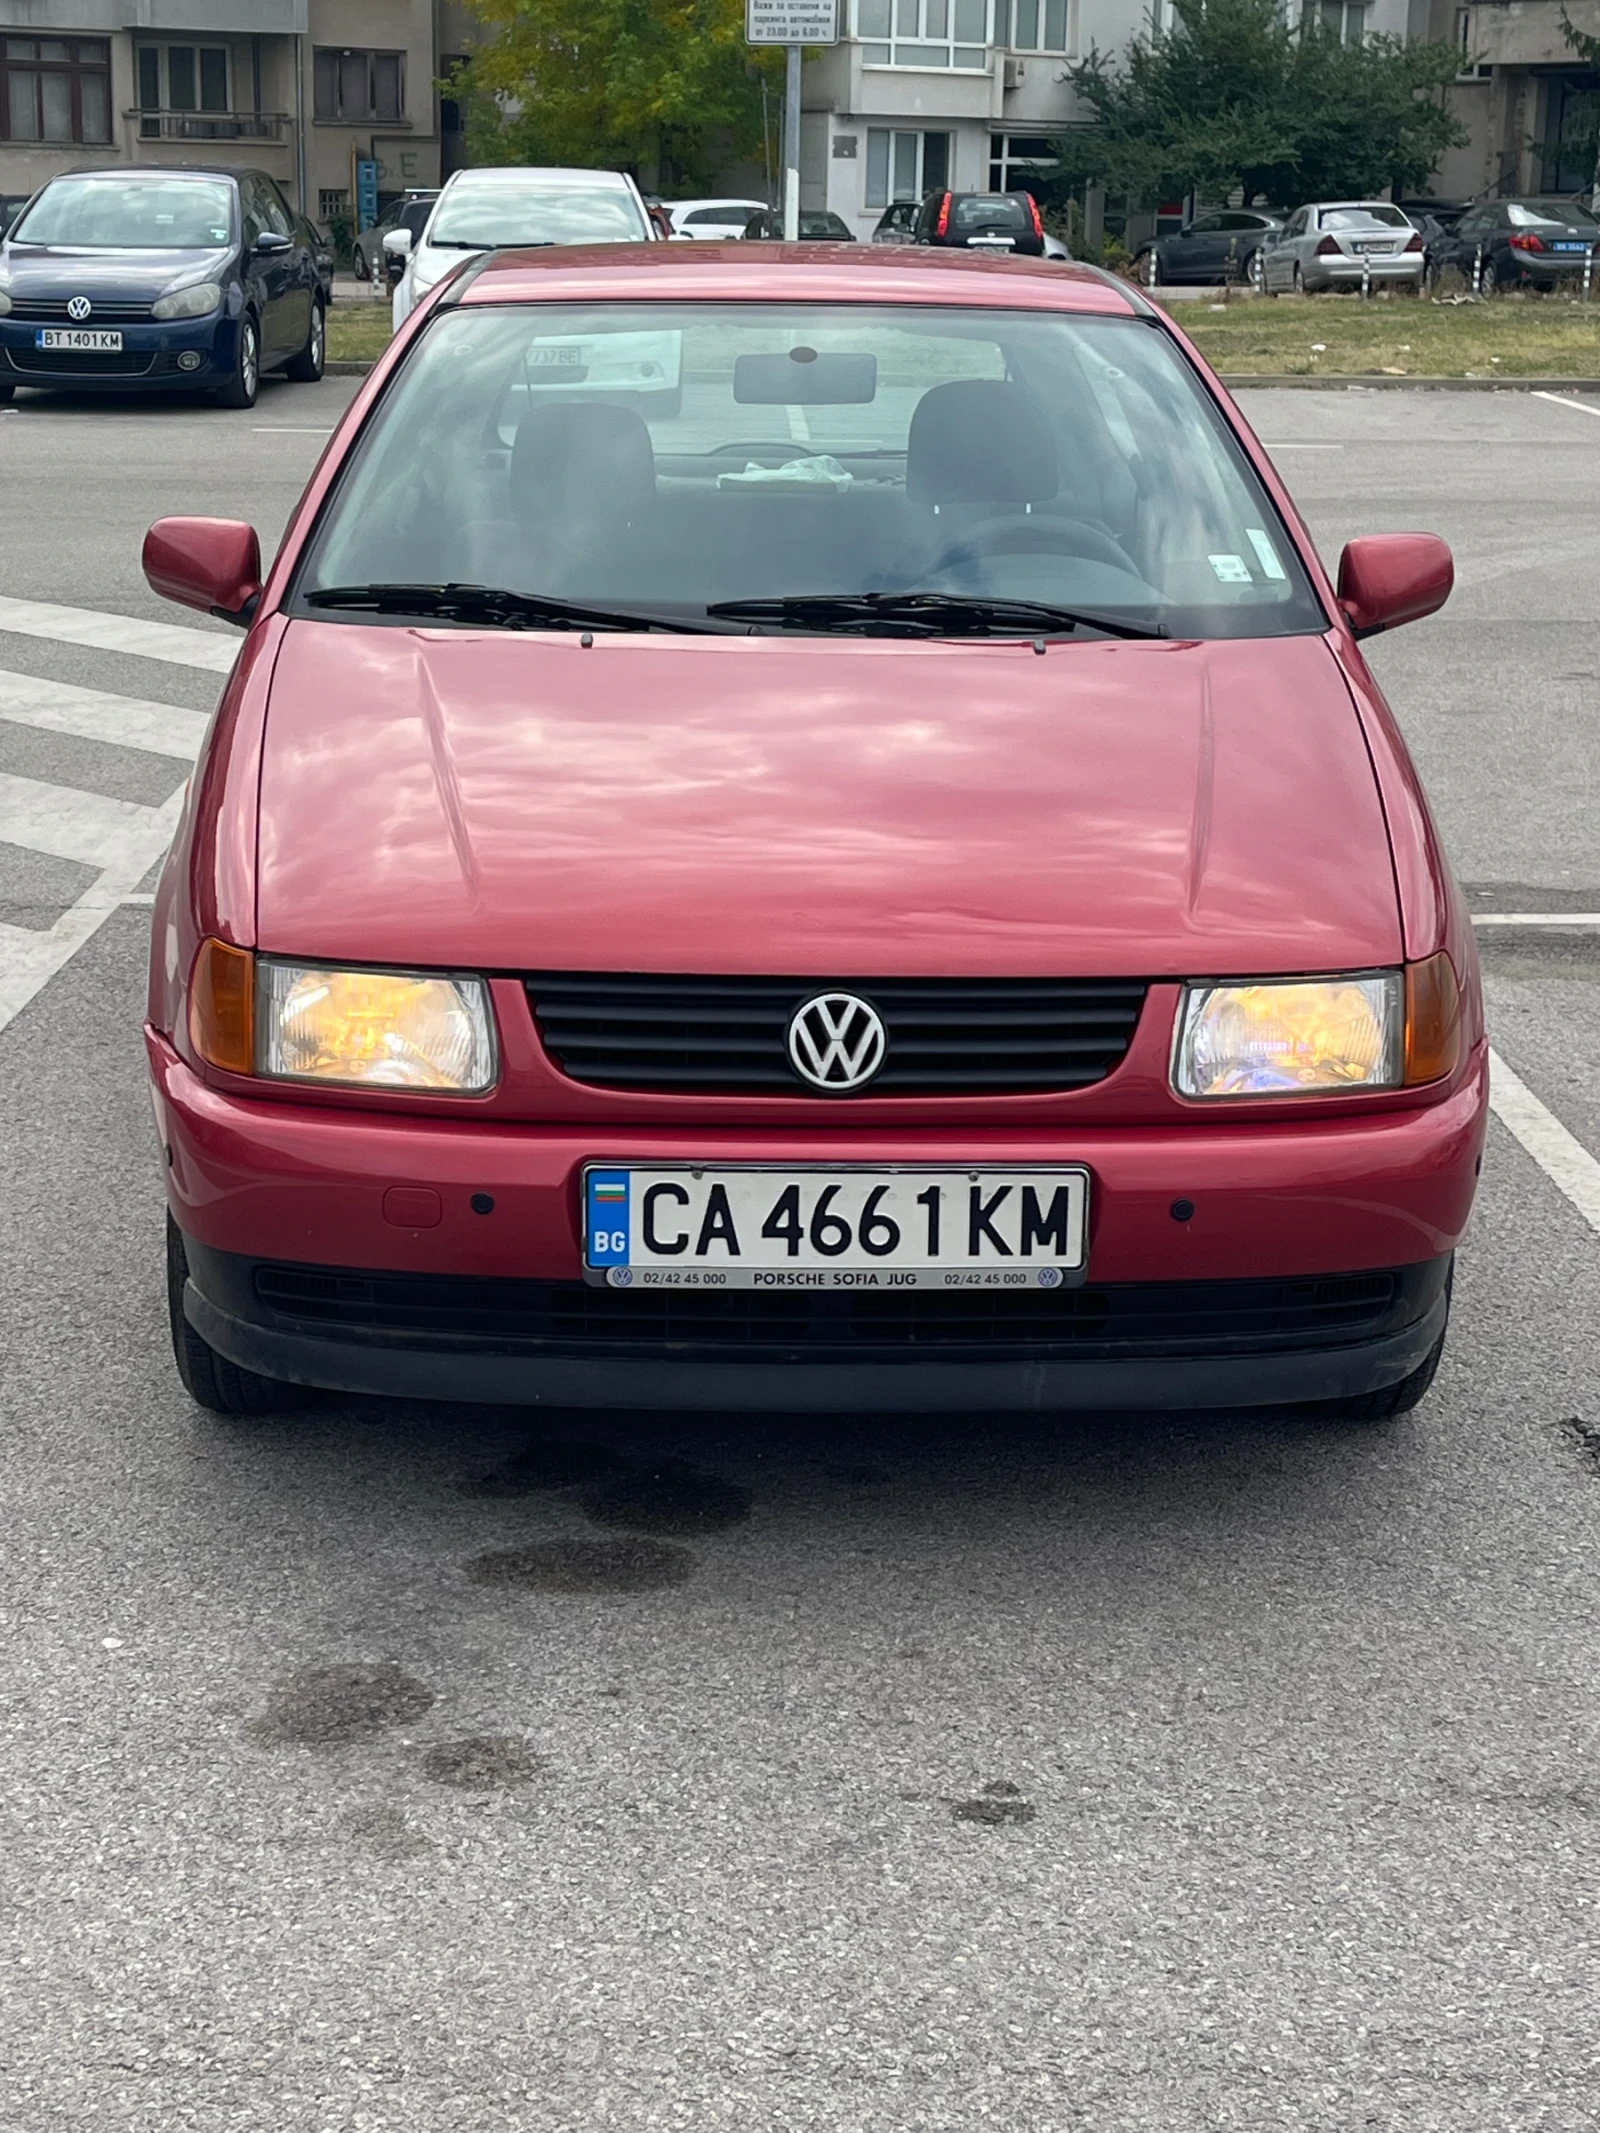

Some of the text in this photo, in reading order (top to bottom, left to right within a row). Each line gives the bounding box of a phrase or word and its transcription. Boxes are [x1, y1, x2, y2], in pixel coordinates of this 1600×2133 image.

[44, 332, 119, 348] BT 1401 KM
[643, 1182, 1069, 1257] CA 4661 KM
[594, 1231, 626, 1252] BG
[643, 1272, 727, 1285] 02/42 45 000
[753, 1272, 918, 1286] PORSCHE SOFIA JUG
[944, 1273, 1027, 1285] 02/42 45 000
